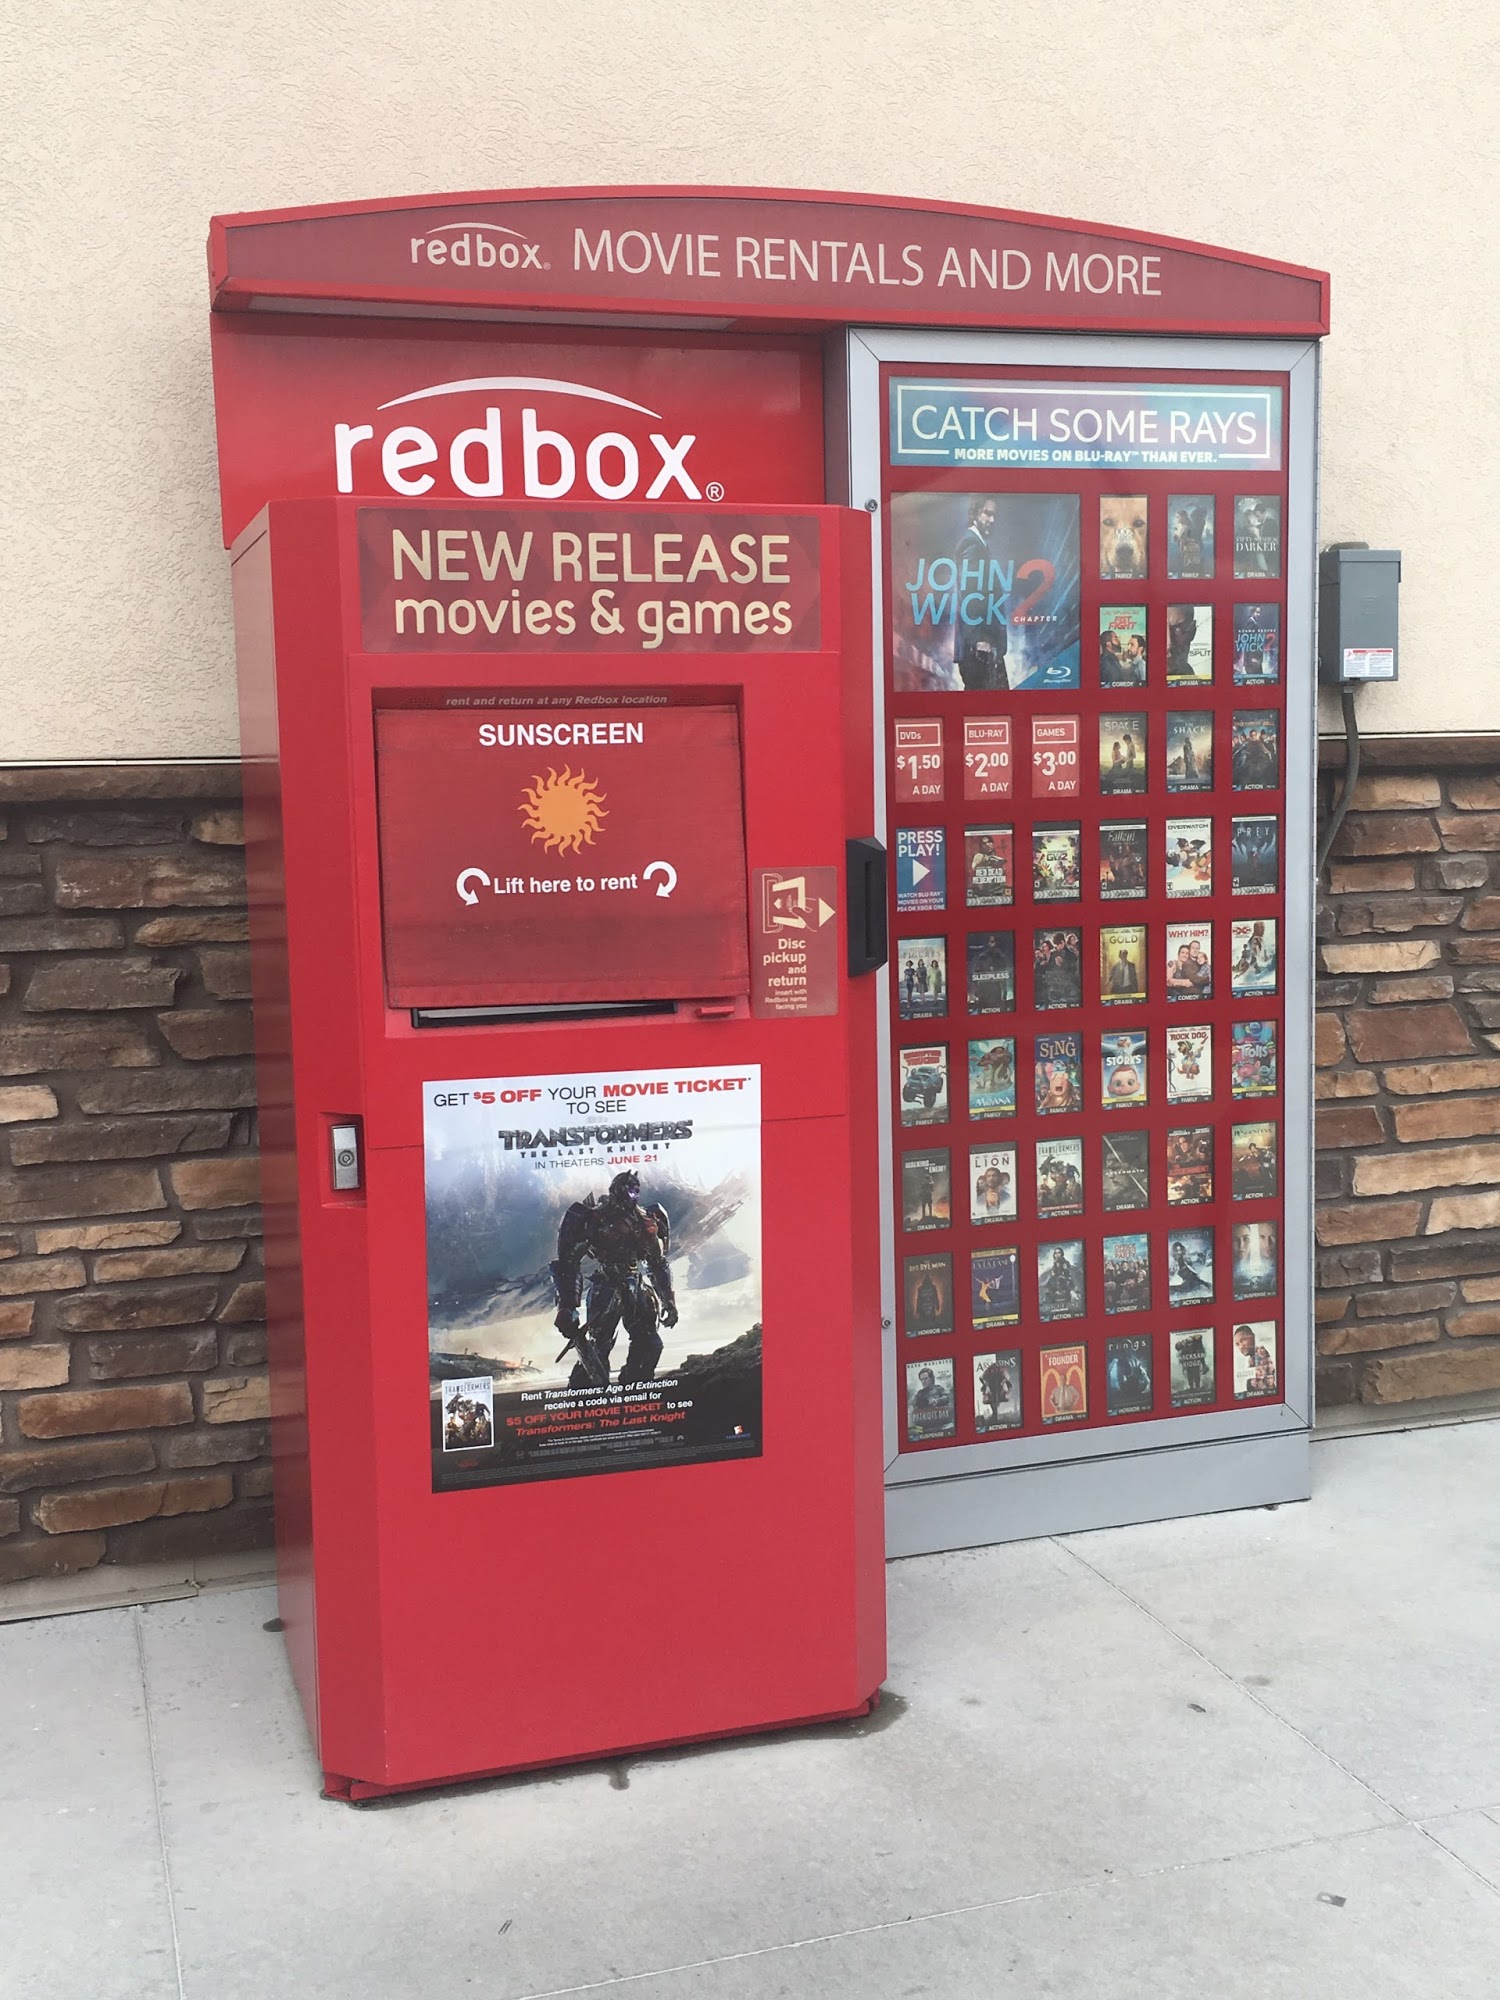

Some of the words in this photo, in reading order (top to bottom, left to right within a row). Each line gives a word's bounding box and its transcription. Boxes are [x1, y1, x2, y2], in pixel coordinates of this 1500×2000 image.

[574, 228, 719, 277] MOVIE
[737, 237, 924, 286] RENTALS
[937, 246, 1032, 290] AND
[1045, 251, 1162, 296] MORE
[911, 404, 1038, 442] CATCH
[1049, 408, 1158, 444] SOME
[1170, 410, 1257, 446] RAYS
[954, 447, 994, 461] MORE
[996, 448, 1049, 462] MOVIES
[1051, 449, 1073, 462] ON
[1141, 451, 1178, 464] THAN
[1235, 542, 1277, 552] DARKER
[392, 528, 533, 582] NEW
[553, 531, 790, 584] RELEASE
[905, 557, 1015, 592] JOHN
[1011, 558, 1056, 626] 2
[911, 592, 1011, 626] WICK
[396, 588, 575, 635] movies
[589, 590, 625, 634] &
[638, 598, 792, 650] games
[1013, 615, 1058, 623] CHAPTER
[1234, 633, 1266, 644] JOHN
[1189, 649, 1212, 658] SPLIT
[1235, 642, 1264, 652] WICK
[446, 696, 470, 707] rent
[471, 695, 495, 706] and
[498, 695, 534, 706] return
[537, 696, 550, 706] at
[552, 696, 572, 708] any
[575, 694, 619, 706] Redbox
[621, 694, 667, 706] location
[478, 722, 644, 747] SUNSCREEN
[899, 731, 922, 741] DVDs
[968, 729, 1003, 739] BLU-RAY
[1037, 728, 1066, 737] GAMES
[1173, 726, 1206, 734] SHACK
[896, 754, 941, 780] $1.50
[965, 752, 1009, 778] $2.00
[1033, 751, 1077, 777] $3.00
[912, 786, 921, 795] A
[921, 784, 941, 795] DAY
[980, 783, 988, 793] A
[989, 782, 1009, 793] DAY
[1048, 781, 1056, 791] A
[1057, 780, 1077, 791] DAY
[897, 830, 944, 845] PRESS
[1236, 826, 1270, 837] PREY
[898, 844, 940, 858] PLAY!
[494, 877, 525, 894] Lift
[530, 876, 571, 893] here
[576, 876, 595, 891] to
[600, 874, 638, 890] rent
[1109, 935, 1139, 945] GOLD
[1168, 929, 1188, 938] WHY
[1189, 928, 1209, 938] HIM?
[777, 938, 807, 950] Disc
[763, 952, 807, 966] pickup
[787, 964, 807, 974] and
[768, 976, 807, 987] return
[971, 972, 1010, 981] SLEEPLESS
[1039, 1040, 1077, 1060] SING
[1105, 1054, 1142, 1067] STORKS
[433, 1092, 470, 1108] GET
[473, 1091, 496, 1105] $5
[500, 1088, 542, 1104] OFF
[547, 1086, 597, 1101] YOUR
[603, 1082, 669, 1098] MOVIE
[566, 1101, 590, 1115] TO
[594, 1099, 627, 1114] SEE
[498, 1119, 693, 1151] TRANSFORMERS
[557, 1147, 595, 1157] LAST
[607, 1142, 671, 1154] KNIGHT
[534, 1160, 547, 1170] IN
[549, 1157, 605, 1169] THEATERS
[607, 1155, 640, 1165] JUNE
[644, 1154, 658, 1163] 21
[974, 1156, 1011, 1169] LION
[1244, 1192, 1264, 1200] ACTION
[1048, 1353, 1079, 1367] FOUNDER
[521, 1392, 542, 1402] Rent
[543, 1386, 604, 1400] Transformers:
[605, 1384, 623, 1395] Age
[625, 1382, 635, 1391] of
[635, 1379, 679, 1391] Extinction
[544, 1401, 576, 1411] receive
[585, 1397, 608, 1407] code
[609, 1396, 622, 1405] via
[624, 1394, 648, 1403] email
[649, 1392, 662, 1401] for
[1183, 1397, 1202, 1405] ACTION
[506, 1416, 522, 1427] $5
[524, 1414, 546, 1425] OFF
[550, 1411, 582, 1422] YOUR
[584, 1406, 621, 1418] MOVIE
[666, 1401, 676, 1410] to
[678, 1400, 693, 1409] see
[516, 1422, 596, 1437] Transformers:
[600, 1418, 620, 1428] The
[622, 1416, 647, 1427] Last
[650, 1411, 686, 1424] Knight
[988, 1423, 1008, 1431] ACTION
